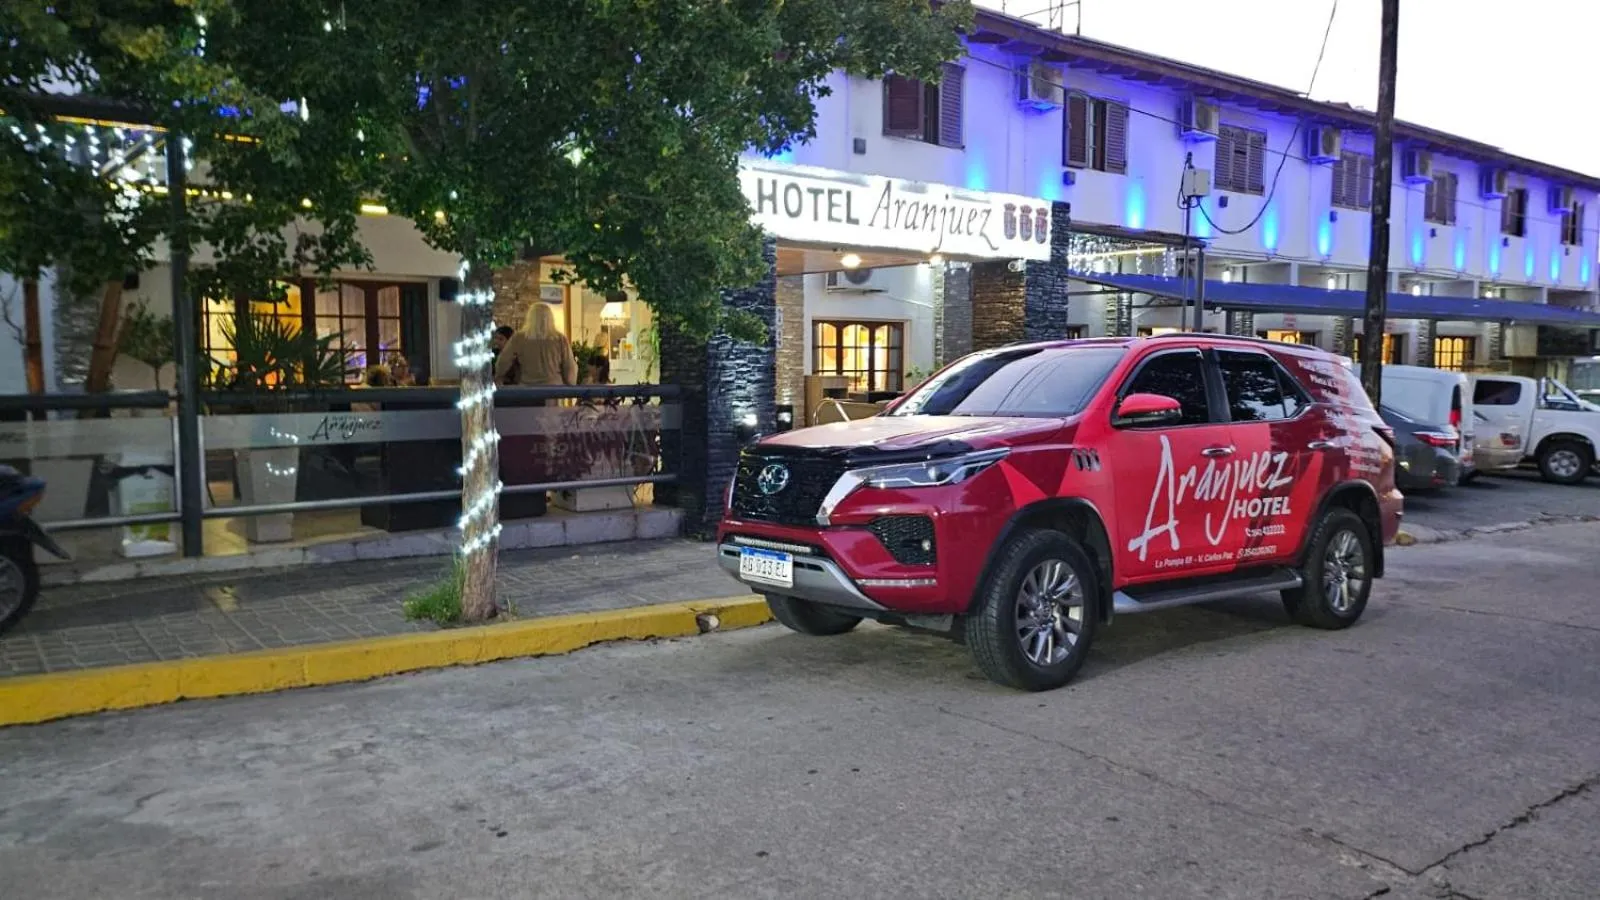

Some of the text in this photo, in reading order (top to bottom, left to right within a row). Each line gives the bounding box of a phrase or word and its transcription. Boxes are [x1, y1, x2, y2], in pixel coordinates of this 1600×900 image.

[756, 177, 999, 251] HOTEL Aranjuez
[1128, 436, 1293, 560] Aranjuez
[1233, 496, 1292, 519] HOTEL
